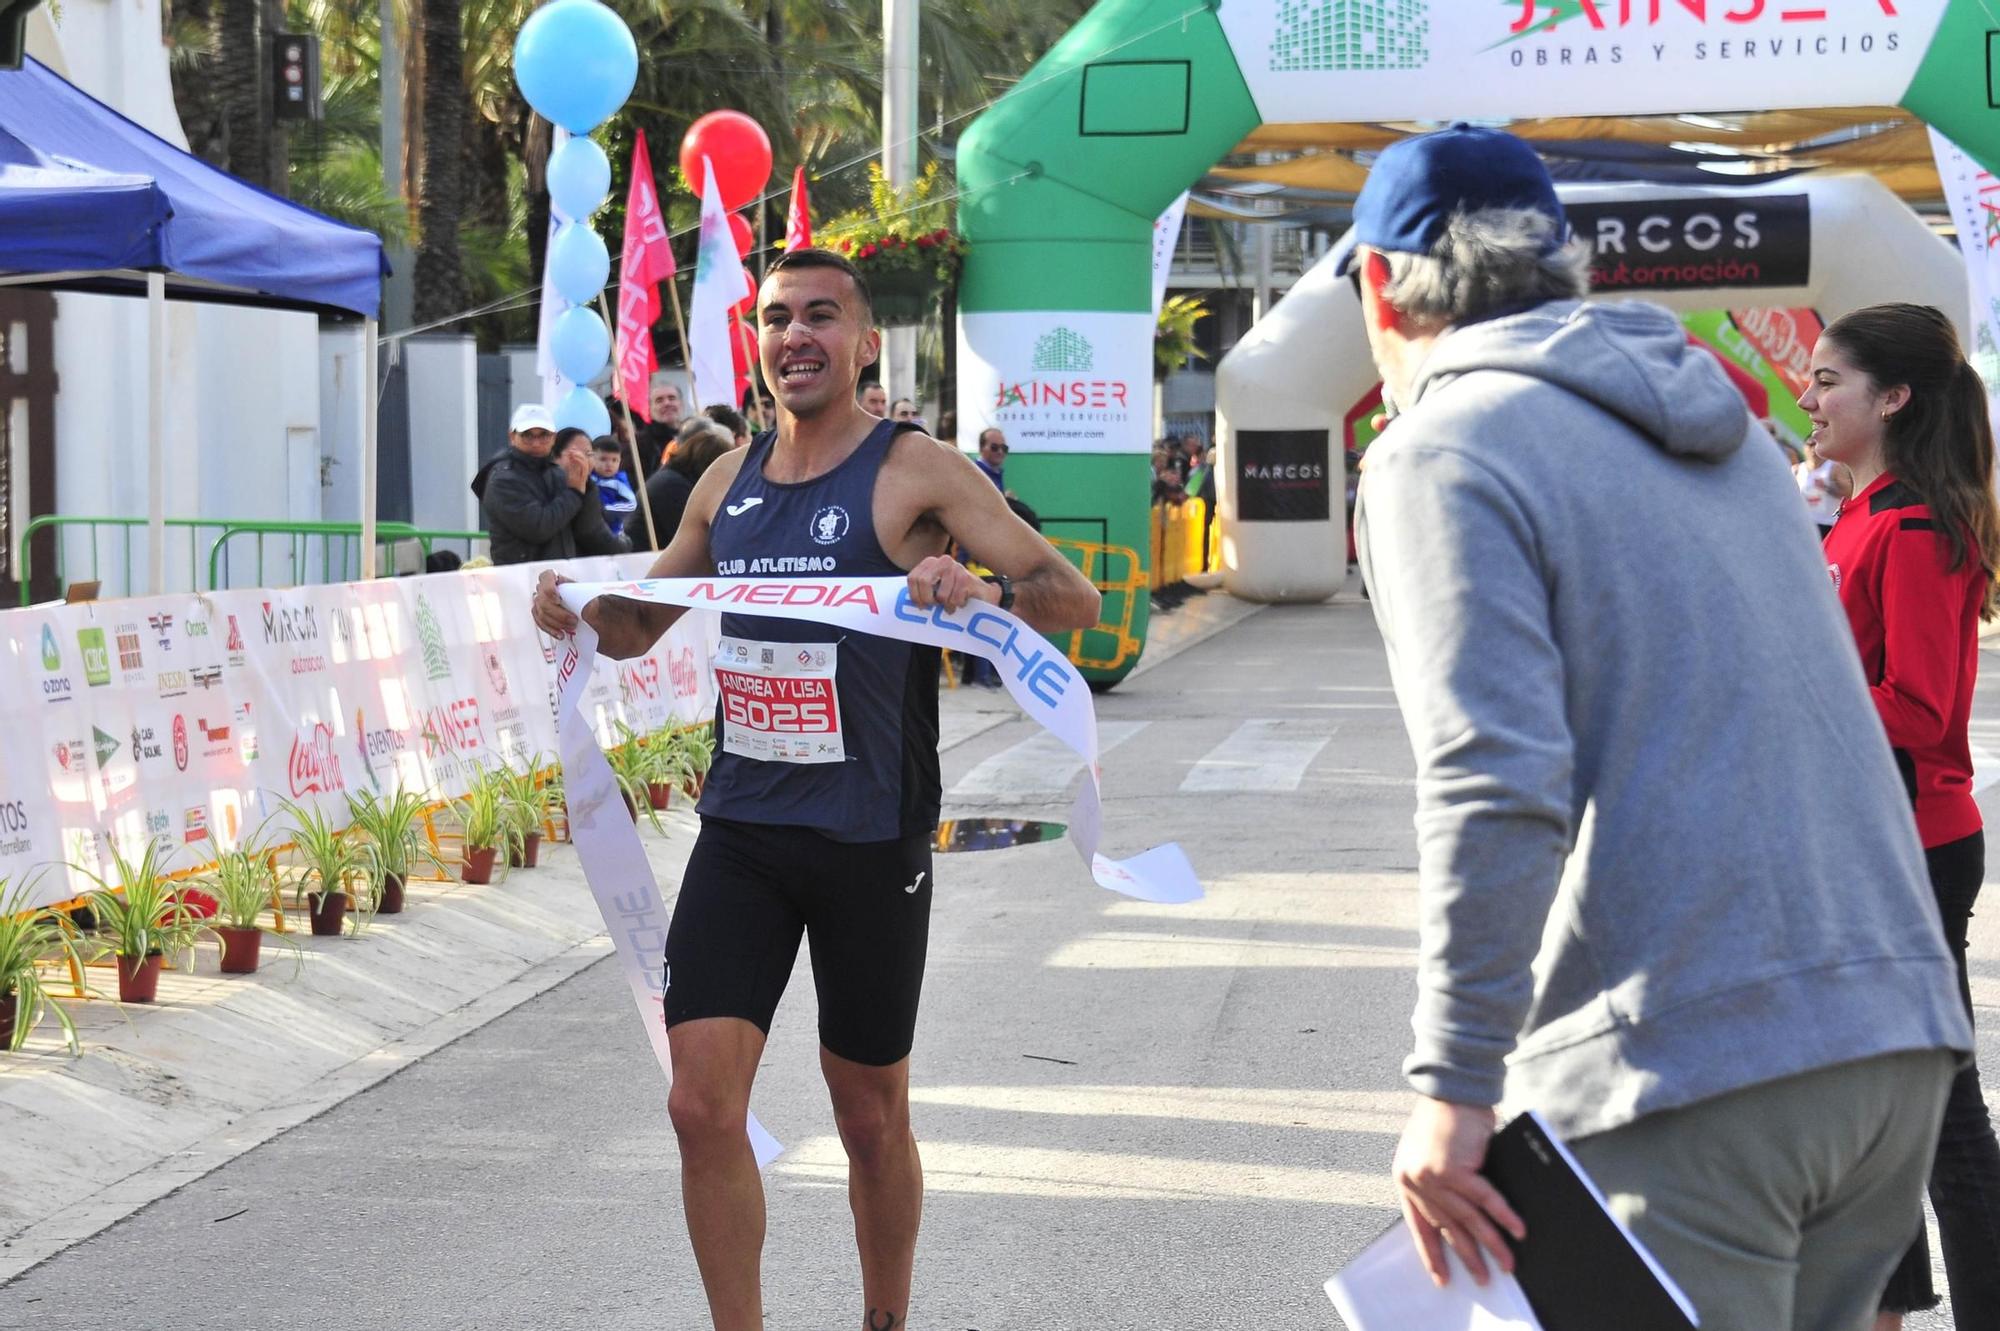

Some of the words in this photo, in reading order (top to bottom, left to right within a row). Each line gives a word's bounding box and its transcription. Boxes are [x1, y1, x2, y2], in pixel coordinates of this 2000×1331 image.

[1510, 45, 1623, 67] OBRAS
[1653, 44, 1665, 61] Y
[1695, 31, 1899, 60] SERVICIOS
[995, 382, 1127, 408] JAINSER
[995, 412, 1034, 421] OBRAS
[1045, 412, 1051, 421] Y
[1061, 412, 1127, 421] SERVICIOS
[1021, 428, 1105, 440] www.jainser.com
[1244, 461, 1322, 479] MARCOS
[717, 559, 746, 576] CLUB
[750, 556, 837, 573] ATLETISMO
[687, 582, 880, 616] MEDIA
[894, 585, 1072, 709] ELCHE
[722, 672, 774, 698] ANDREA
[776, 680, 788, 698] Y
[790, 680, 828, 698] LISA
[727, 692, 830, 732] 5025
